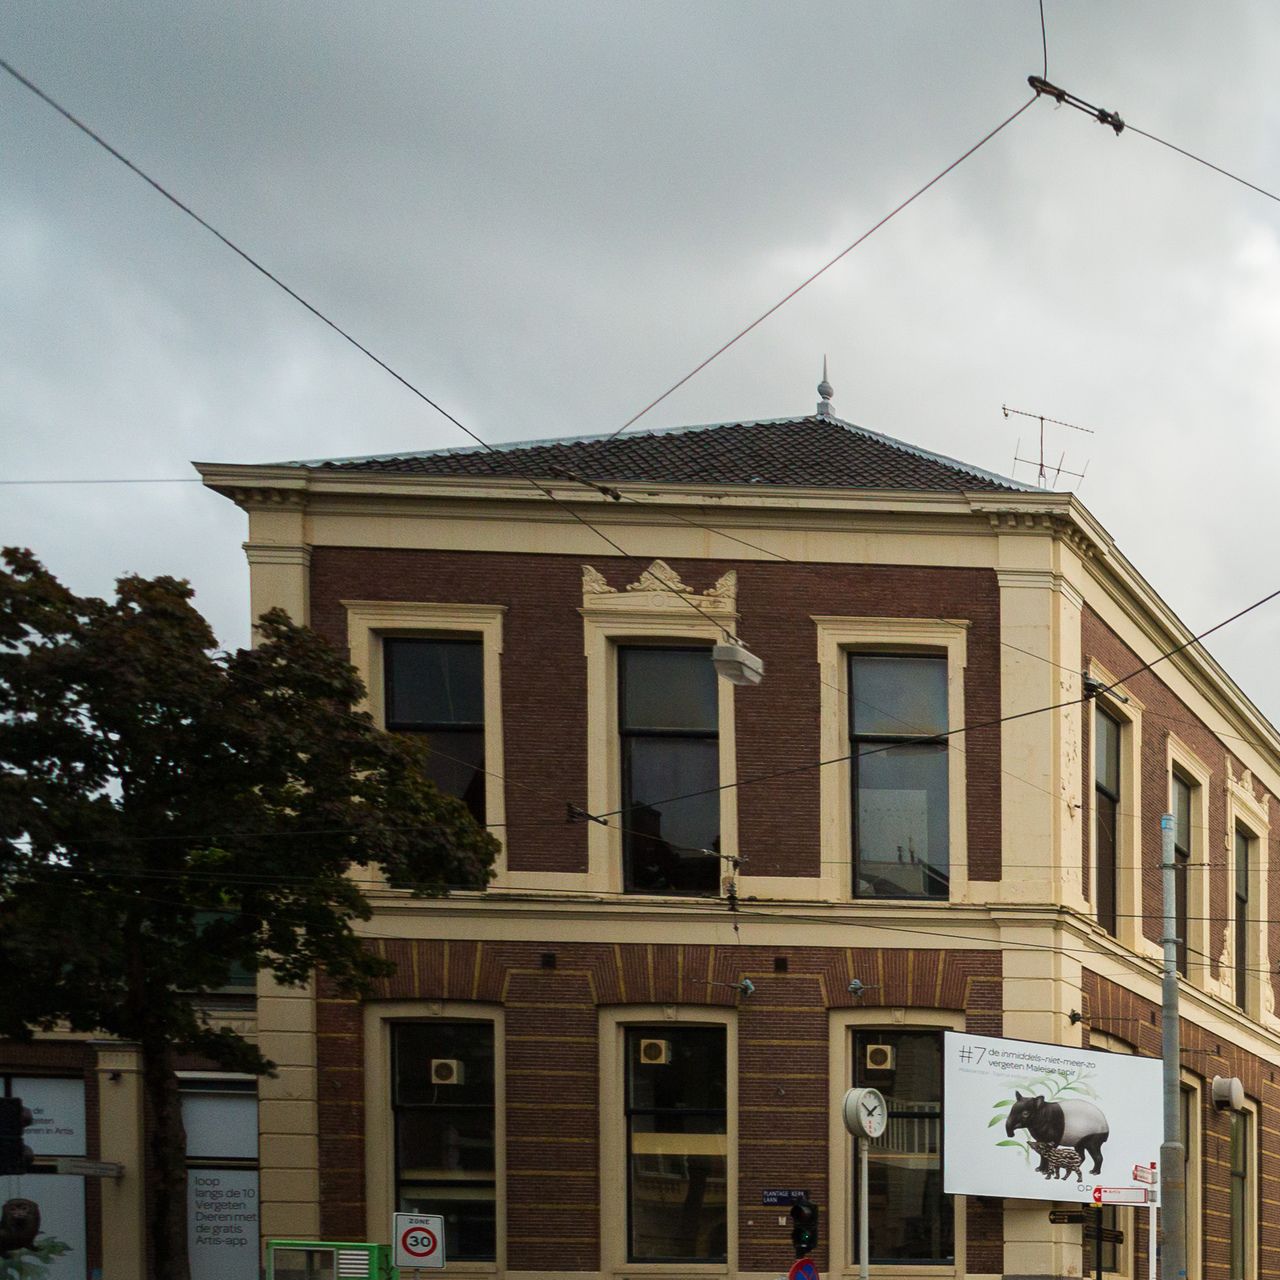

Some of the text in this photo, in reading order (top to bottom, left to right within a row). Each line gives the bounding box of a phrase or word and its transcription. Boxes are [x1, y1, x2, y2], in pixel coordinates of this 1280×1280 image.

[959, 1045, 987, 1065] #7
[988, 1048, 1000, 1057] de
[988, 1060, 1025, 1071] vergeten
[1026, 1063, 1057, 1075] Maleise
[1057, 1066, 1076, 1078] tapir
[195, 1176, 220, 1187] loop
[195, 1188, 256, 1201] langs de 10
[195, 1200, 247, 1212] Vergeten
[195, 1212, 257, 1222] Dieren met
[408, 1218, 432, 1226] ZONE
[195, 1224, 243, 1236] de gratis
[195, 1236, 248, 1247] Artis-app
[409, 1235, 432, 1248] 30
